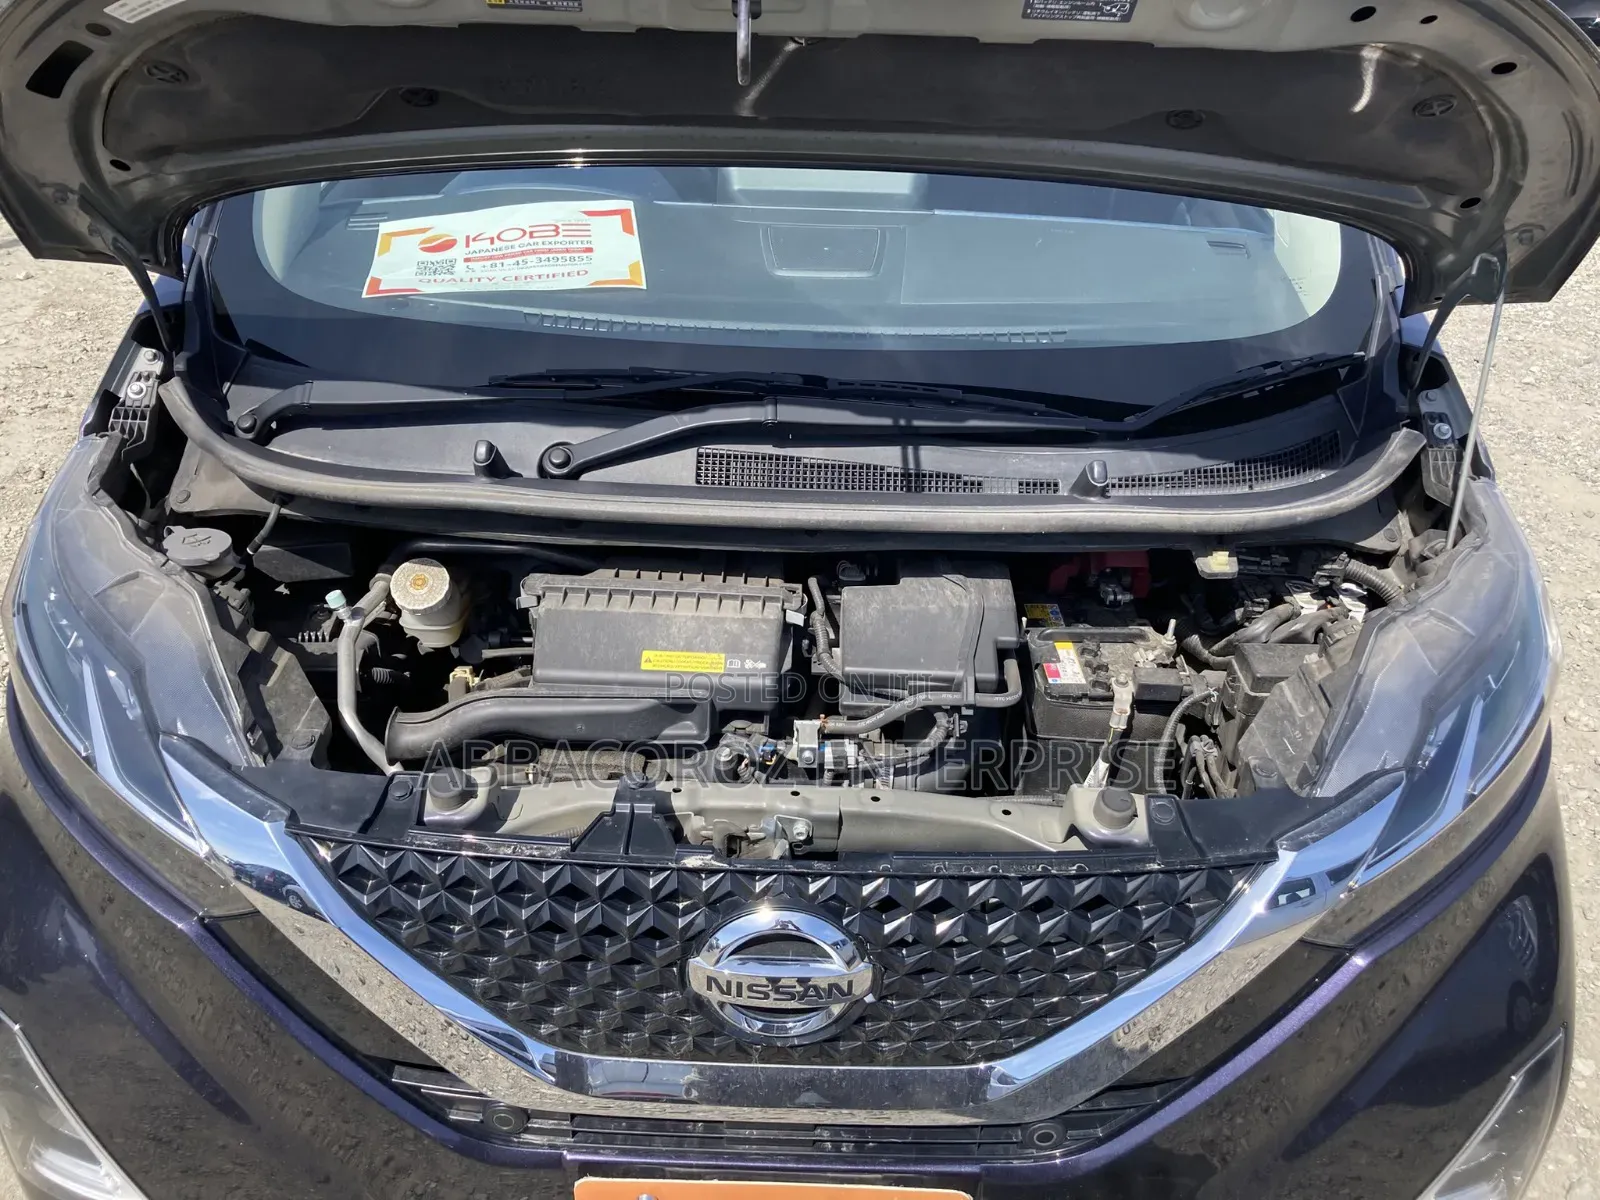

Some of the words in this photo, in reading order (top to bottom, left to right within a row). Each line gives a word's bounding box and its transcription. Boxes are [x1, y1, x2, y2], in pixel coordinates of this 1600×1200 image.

[465, 244, 516, 256] JAPANESE
[518, 240, 540, 249] CAR
[541, 239, 593, 247] EXPORTER
[481, 255, 593, 269] +81-45-3495855
[418, 275, 497, 285] QUALITY
[502, 269, 589, 282] CERTIFIED
[706, 974, 854, 1002] NISSAN
